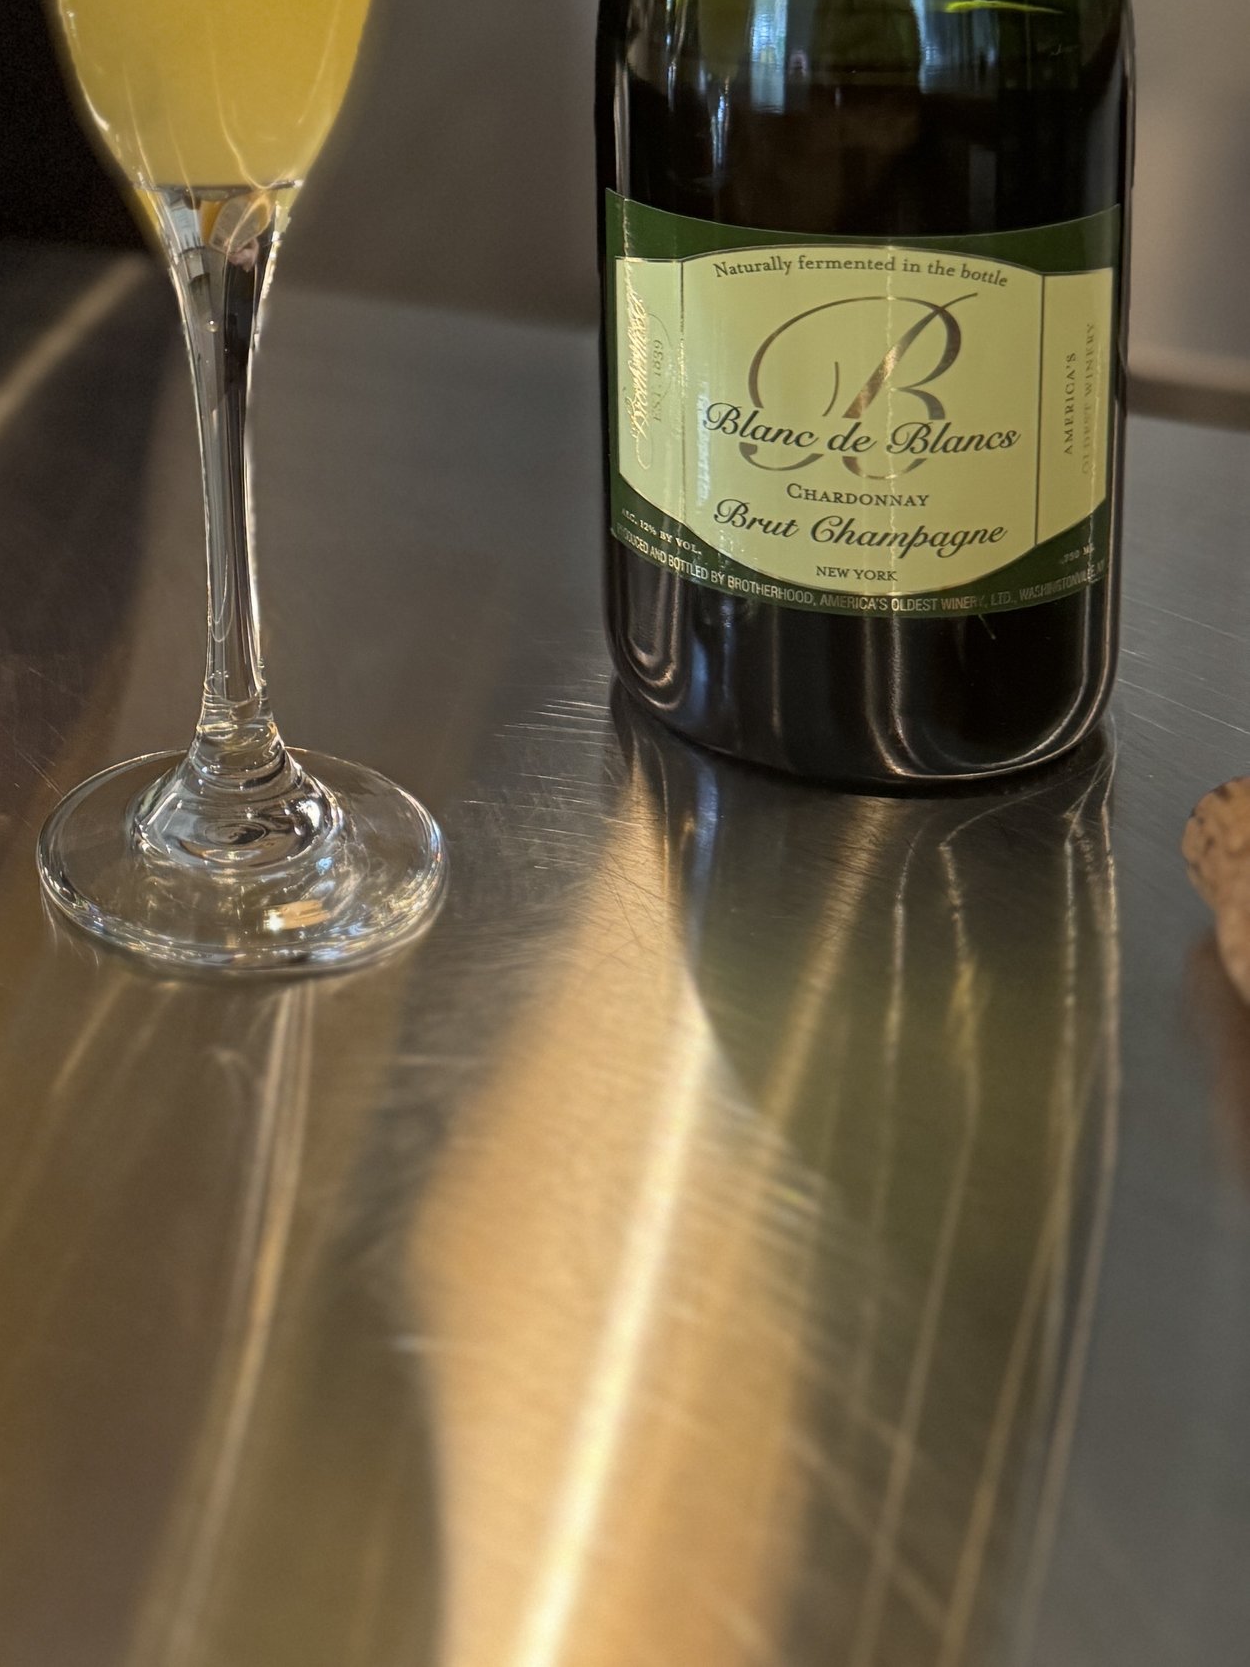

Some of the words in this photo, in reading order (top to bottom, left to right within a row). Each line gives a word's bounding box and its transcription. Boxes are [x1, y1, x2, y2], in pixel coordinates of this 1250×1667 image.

[713, 255, 793, 277] Naturally
[797, 255, 896, 271] fermented
[902, 255, 921, 274] in
[927, 260, 956, 278] the
[960, 262, 1008, 288] bottle
[1064, 352, 1077, 455] AMERICA'S
[703, 401, 819, 449] Blanc
[826, 421, 877, 454] de
[886, 421, 1021, 455] Blancs
[786, 483, 930, 507] CHARDONNAY
[659, 530, 673, 544] BY
[675, 537, 703, 556] VOL.
[713, 498, 800, 538] Brut
[810, 515, 1008, 559] Champagne
[616, 522, 649, 555] ODUCED
[650, 545, 668, 564] AND
[668, 553, 709, 580] BOTTLED
[710, 570, 725, 585] BY
[727, 575, 817, 607] BROTHERHOOD,
[820, 592, 887, 611] AMERICA'S
[891, 597, 938, 612] OLDEST
[815, 565, 850, 579] NEW
[851, 567, 899, 582] YORK
